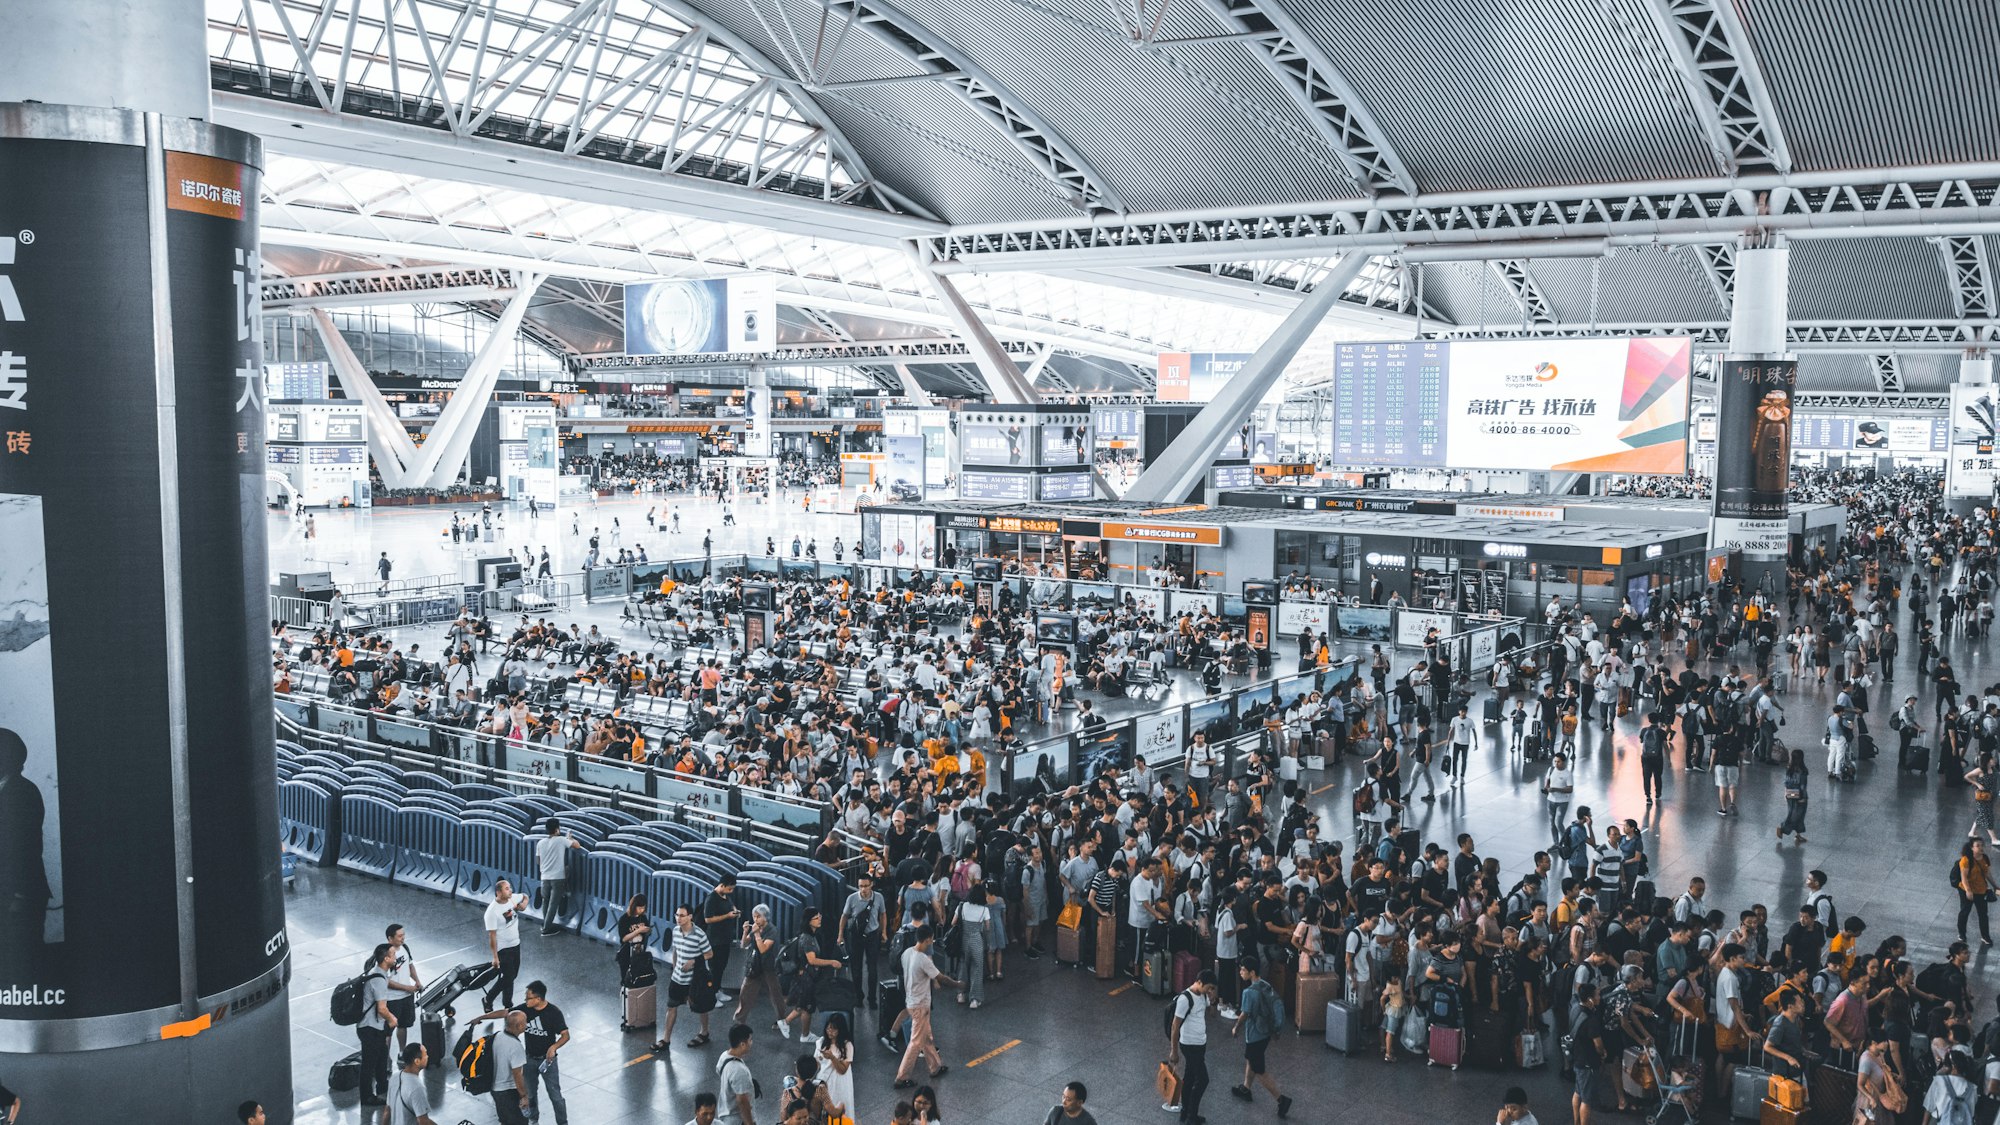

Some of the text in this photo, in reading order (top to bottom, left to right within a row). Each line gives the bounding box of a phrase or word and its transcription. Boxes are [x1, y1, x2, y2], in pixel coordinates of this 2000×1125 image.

[181, 179, 242, 206] 诺贝尔 瓷砖
[1742, 366, 1795, 385] 明珠台
[553, 383, 579, 393] 德克士
[1467, 399, 1596, 416] 高铁广告 找永达
[6, 430, 32, 455] 砖
[1326, 500, 1354, 508] GRCBANK
[1364, 501, 1408, 511] 广州农商银行
[1724, 540, 1741, 549] 186
[1745, 541, 1770, 550] 8888
[265, 928, 285, 956] CCTV
[0, 984, 66, 1006] abel.cc
